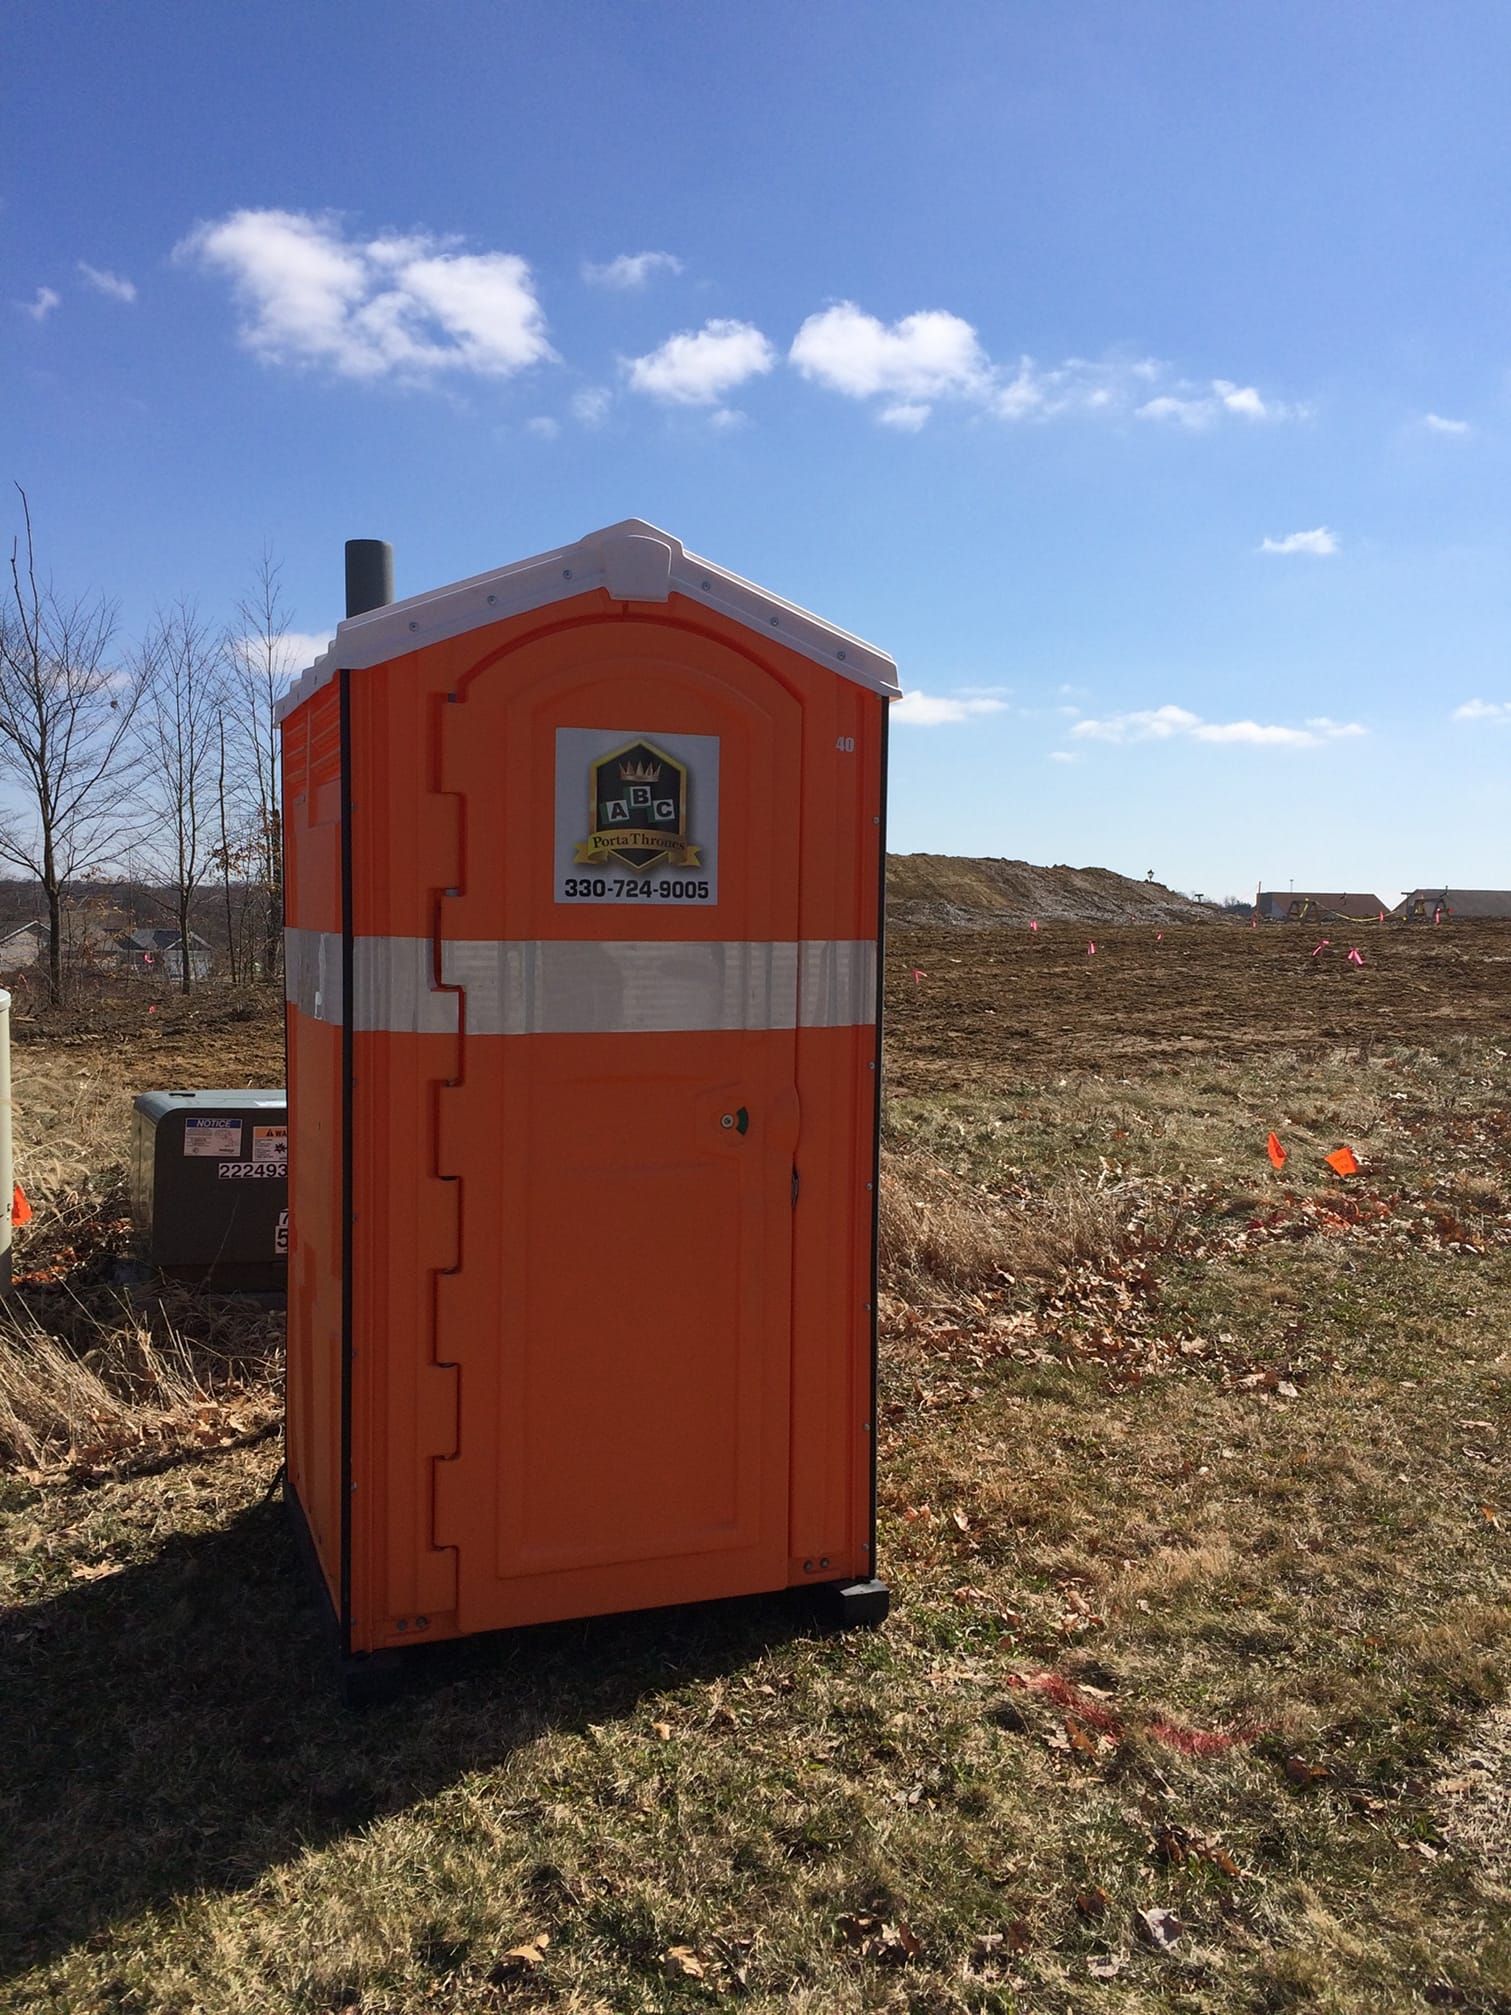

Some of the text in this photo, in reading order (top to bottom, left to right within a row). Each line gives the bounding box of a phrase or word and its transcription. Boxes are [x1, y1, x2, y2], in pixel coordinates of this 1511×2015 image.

[835, 735, 855, 752] 40
[593, 833, 685, 850] Porta Thrones
[565, 878, 709, 899] 330-724-9005
[196, 1119, 231, 1128] NOTICE
[220, 1164, 288, 1178] 222493
